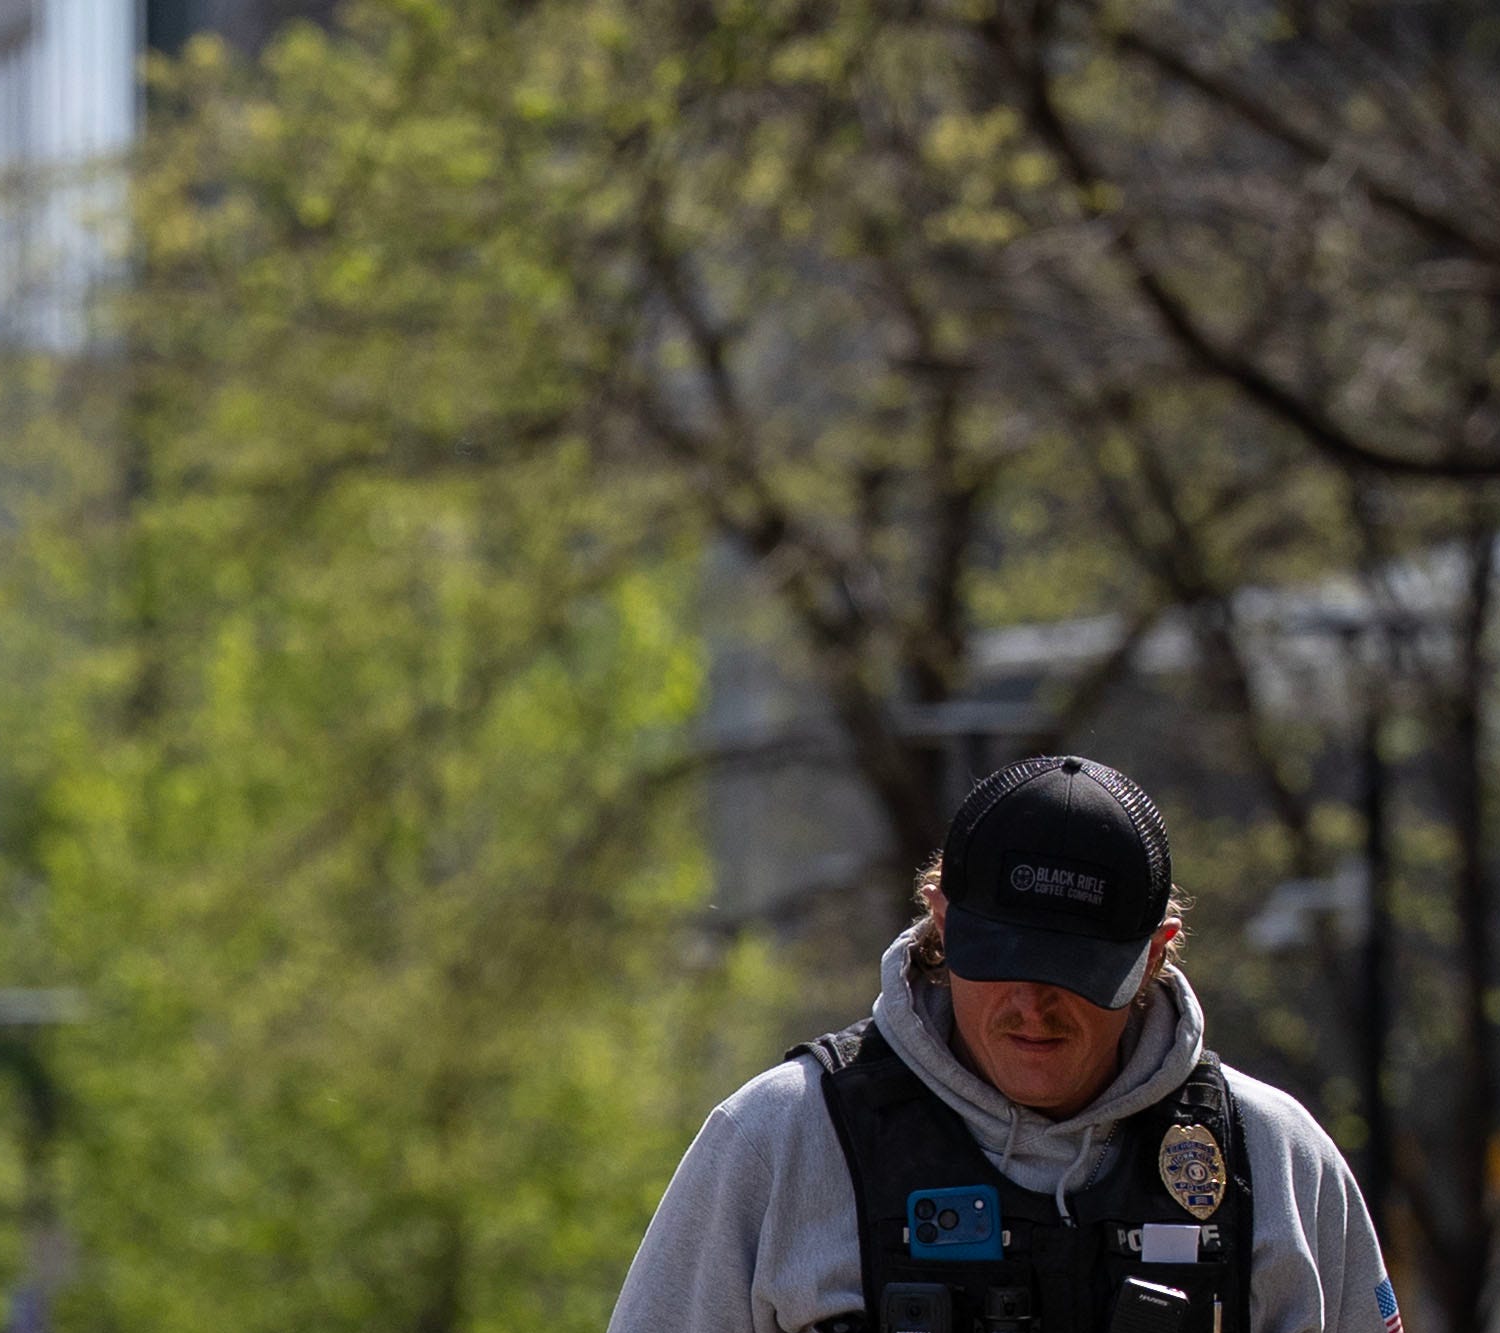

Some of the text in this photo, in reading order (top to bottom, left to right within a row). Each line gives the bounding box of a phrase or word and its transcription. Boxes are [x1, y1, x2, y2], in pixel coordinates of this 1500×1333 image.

[1036, 867, 1106, 894] BLACK RIFLE
[1034, 882, 1104, 905] COFFEE COMPANY
